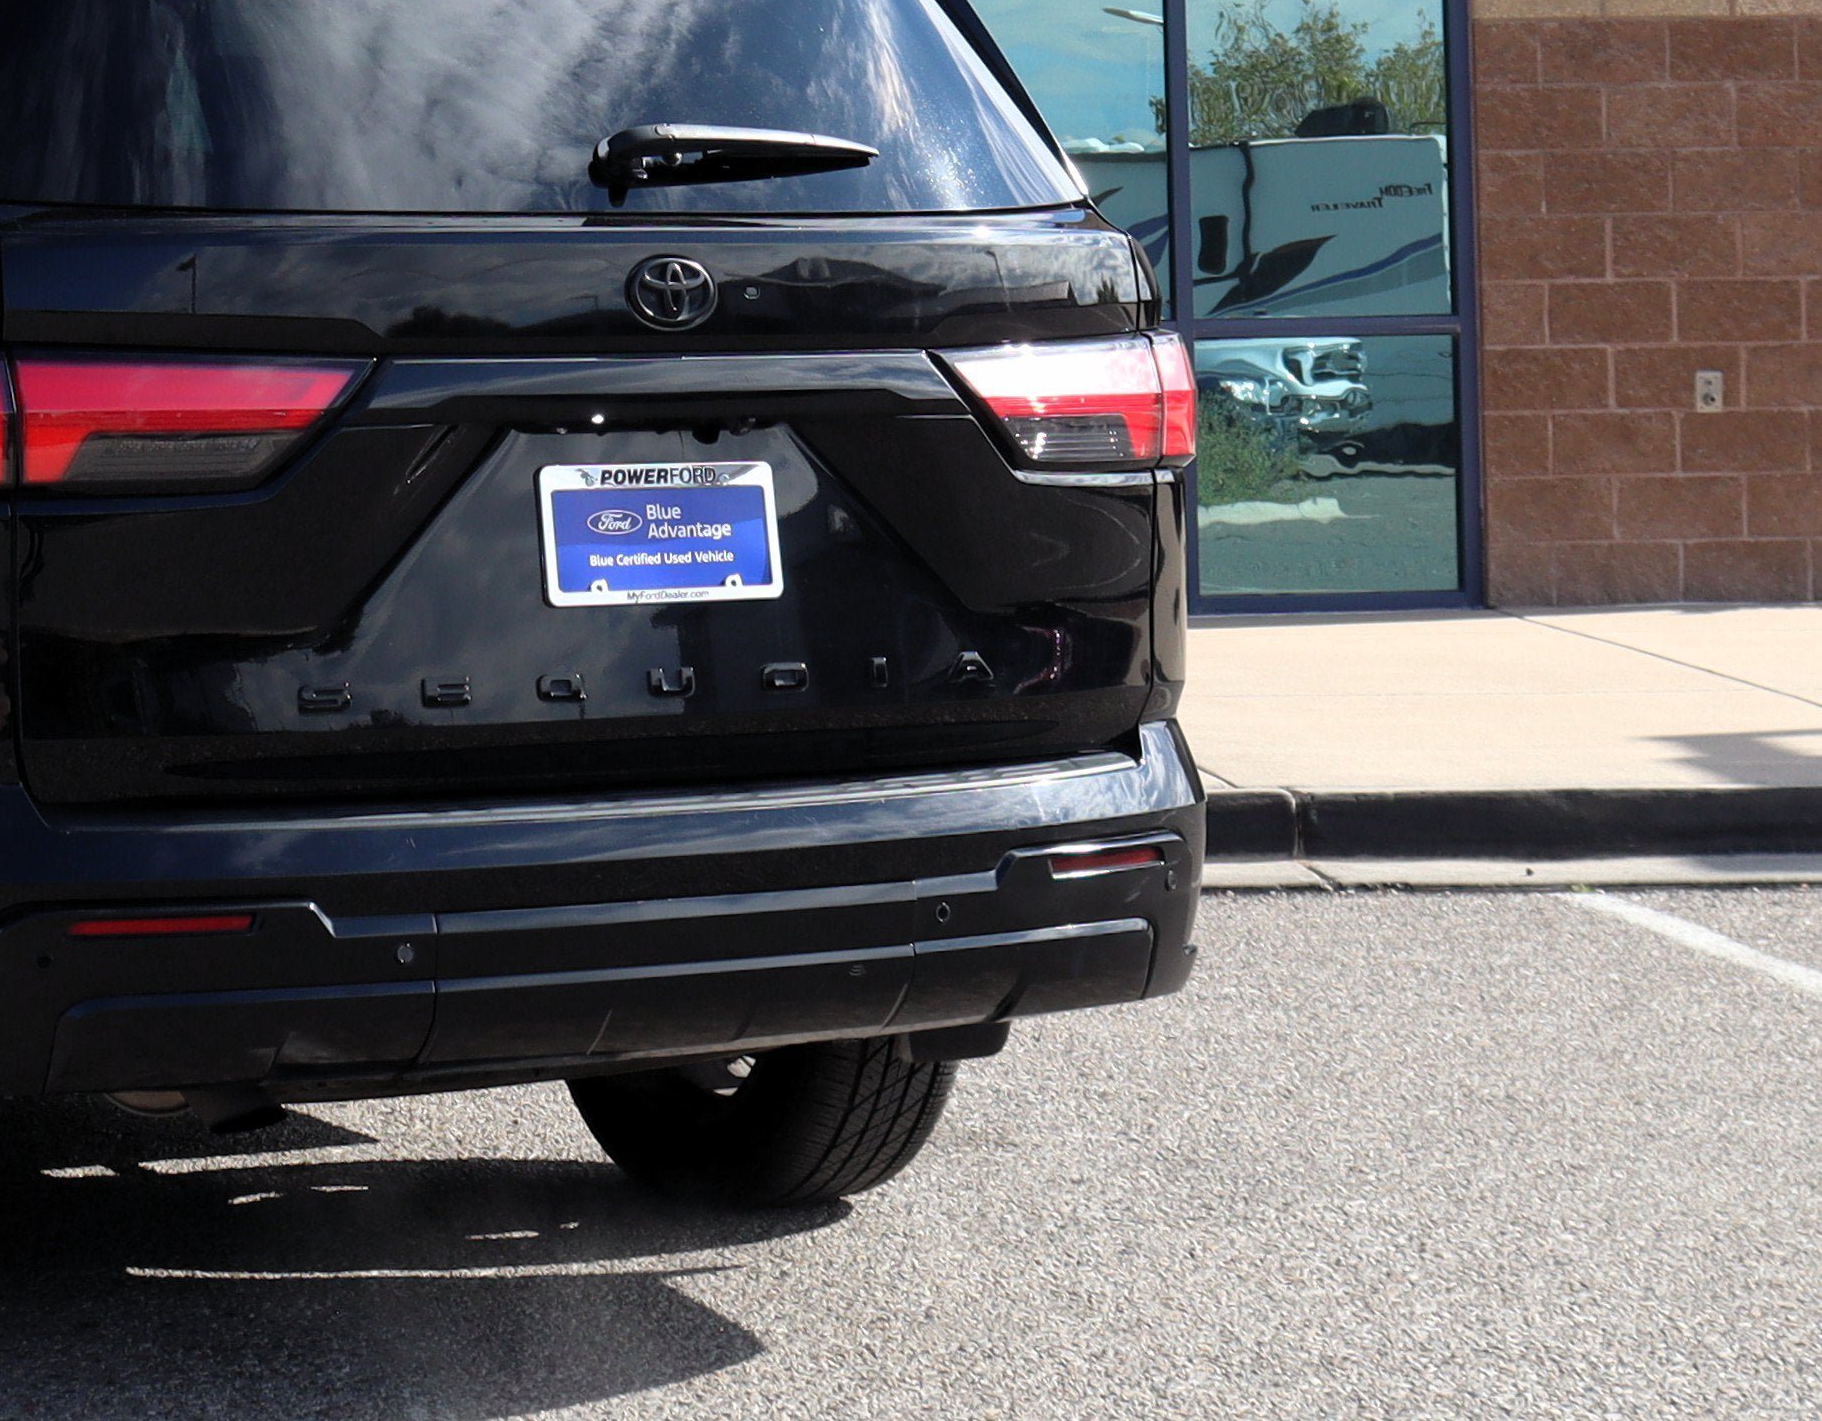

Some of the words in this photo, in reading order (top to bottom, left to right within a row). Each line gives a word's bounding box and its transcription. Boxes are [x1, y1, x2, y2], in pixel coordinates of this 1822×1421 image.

[645, 503, 682, 520] Blue
[598, 513, 632, 530] Ford
[647, 521, 732, 540] Advantage
[589, 554, 614, 567] Blue
[616, 551, 662, 566] Certified
[664, 550, 692, 564] Used
[694, 549, 735, 563] Vehicle
[296, 651, 993, 711] SEQUOIA
